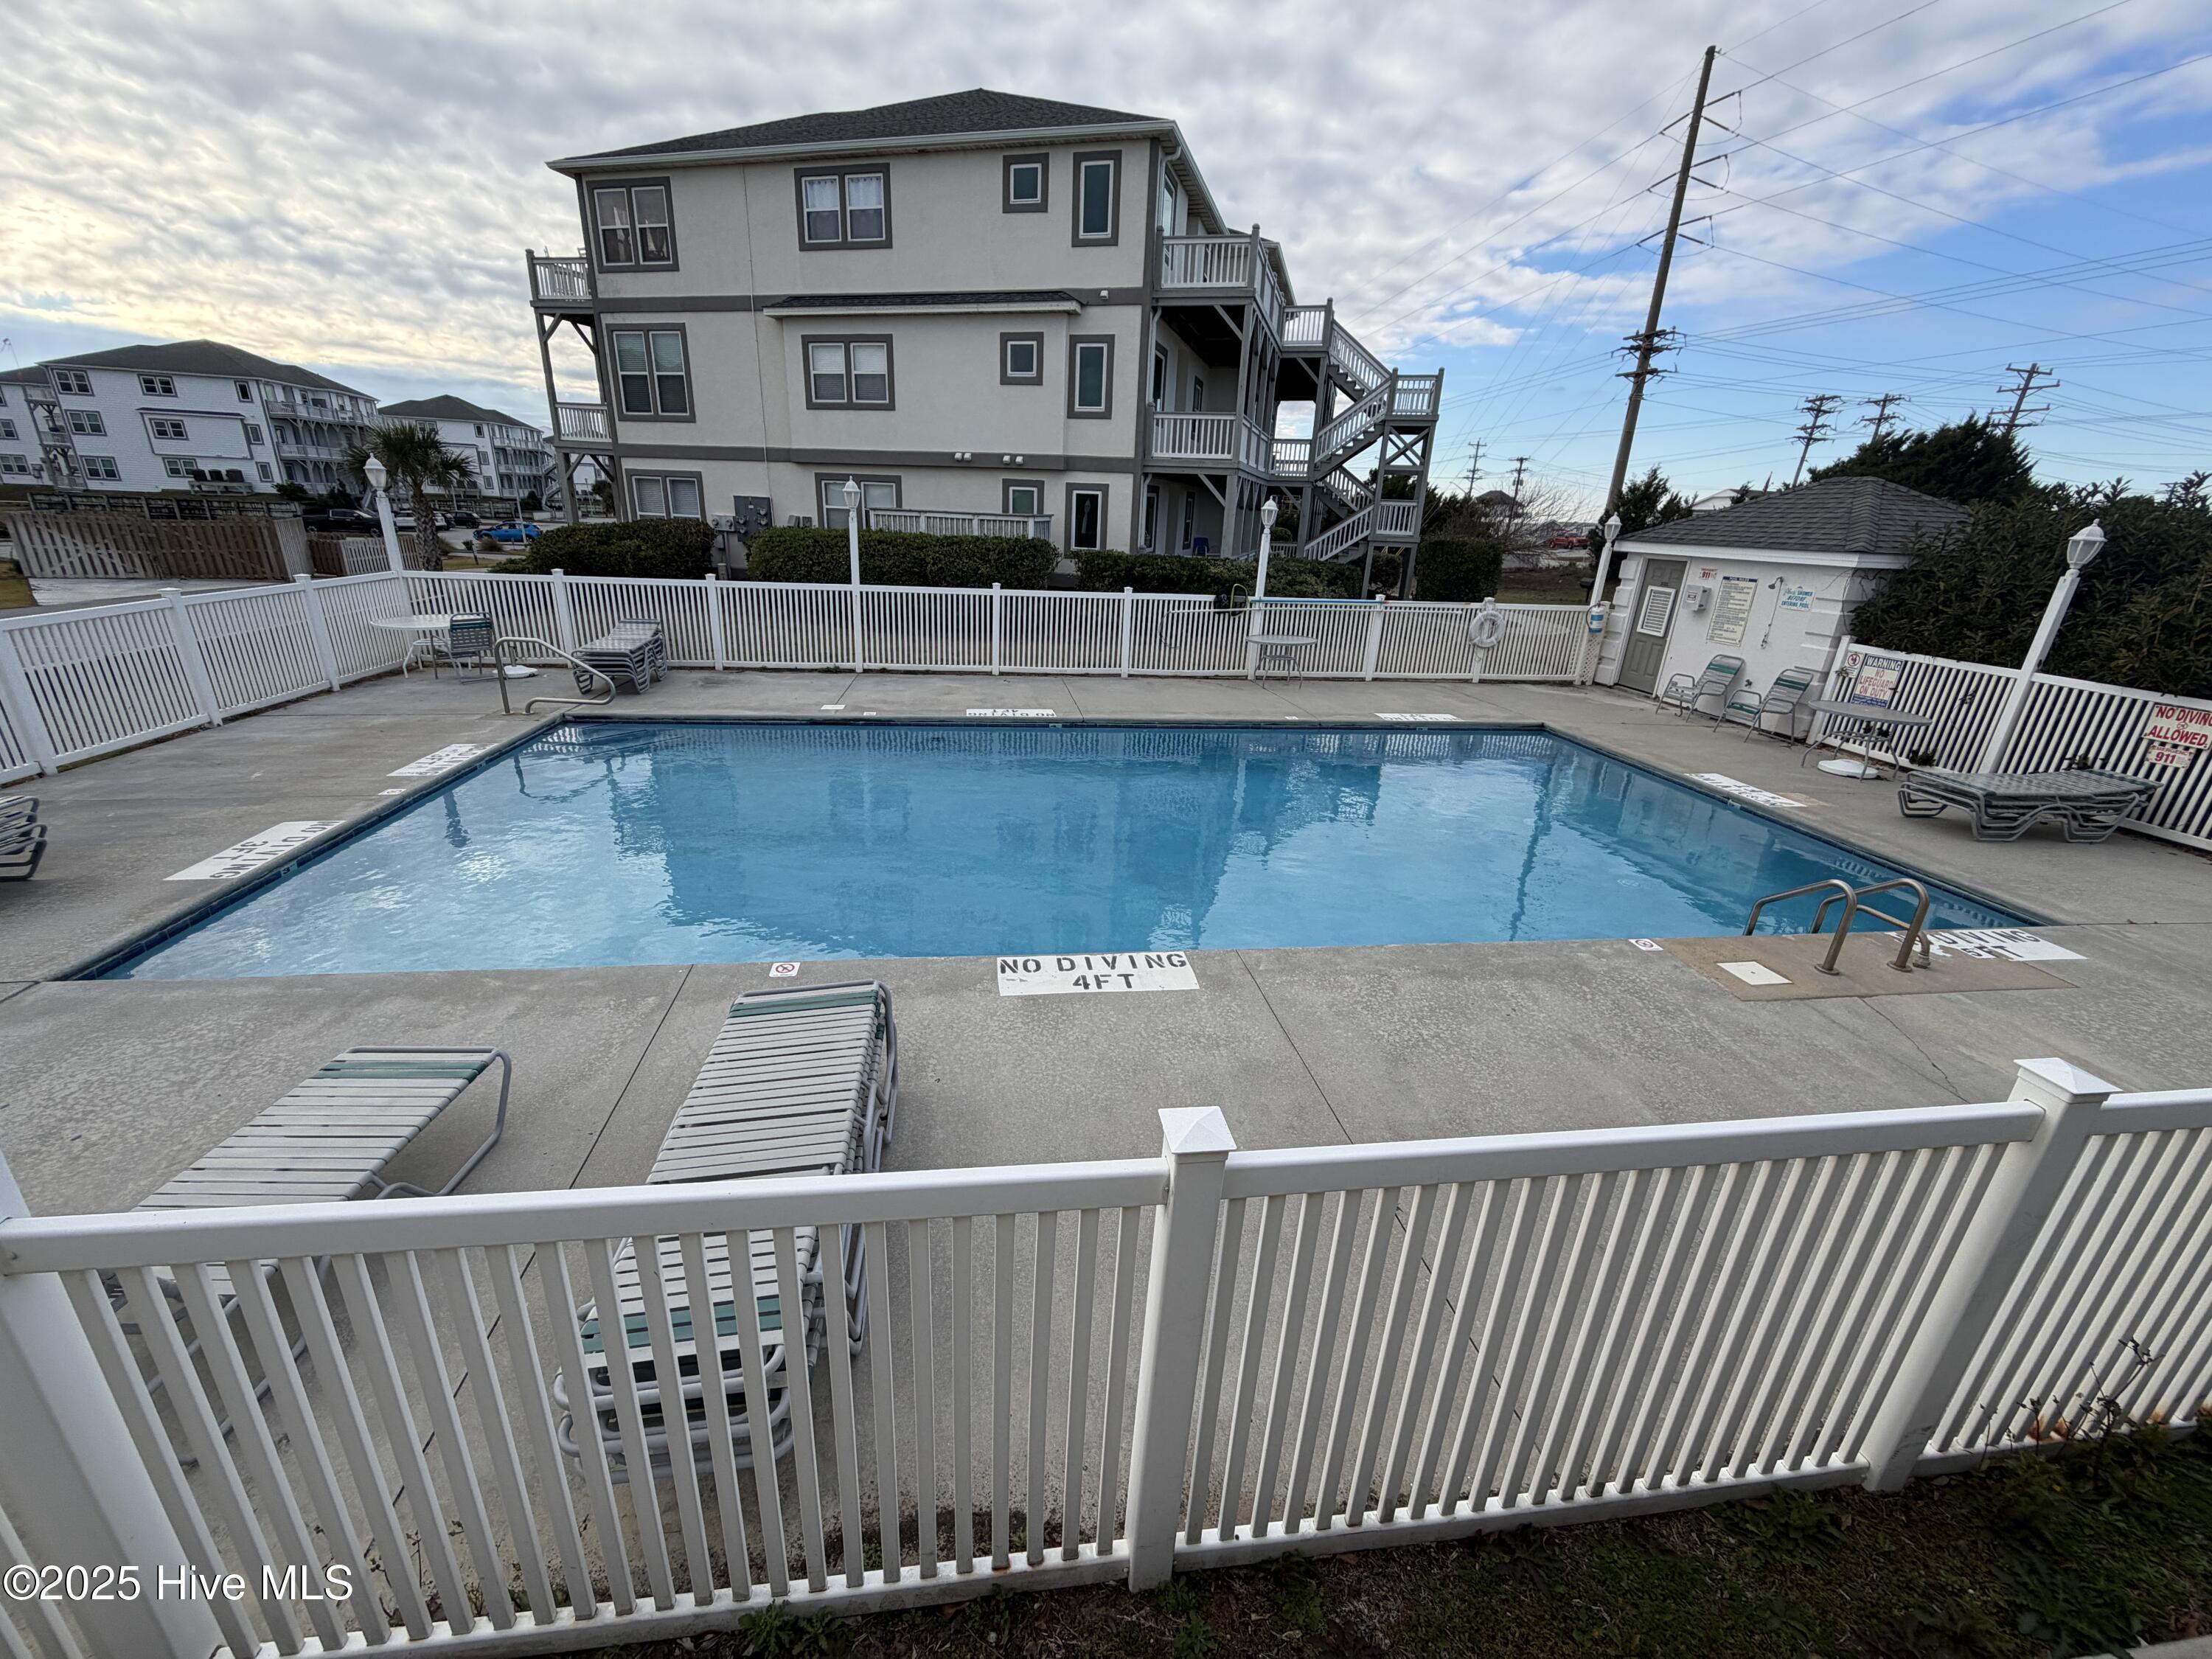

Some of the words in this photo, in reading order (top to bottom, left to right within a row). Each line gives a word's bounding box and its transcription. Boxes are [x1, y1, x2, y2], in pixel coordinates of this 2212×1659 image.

[1866, 655, 1902, 671] WARNING
[1875, 668, 1885, 678] NO
[1859, 675, 1894, 689] LIFEGUARD
[1860, 685, 1869, 695] ON
[1870, 687, 1888, 698] DUTY
[2156, 706, 2176, 720] NO
[2147, 725, 2208, 746] ALLOWED
[2154, 751, 2177, 764] 911
[209, 836, 311, 878] DIVING
[212, 841, 268, 860] 3FT
[1000, 959, 1041, 974] NO
[1056, 953, 1187, 972] DIVING
[1073, 973, 1135, 990] 4FT
